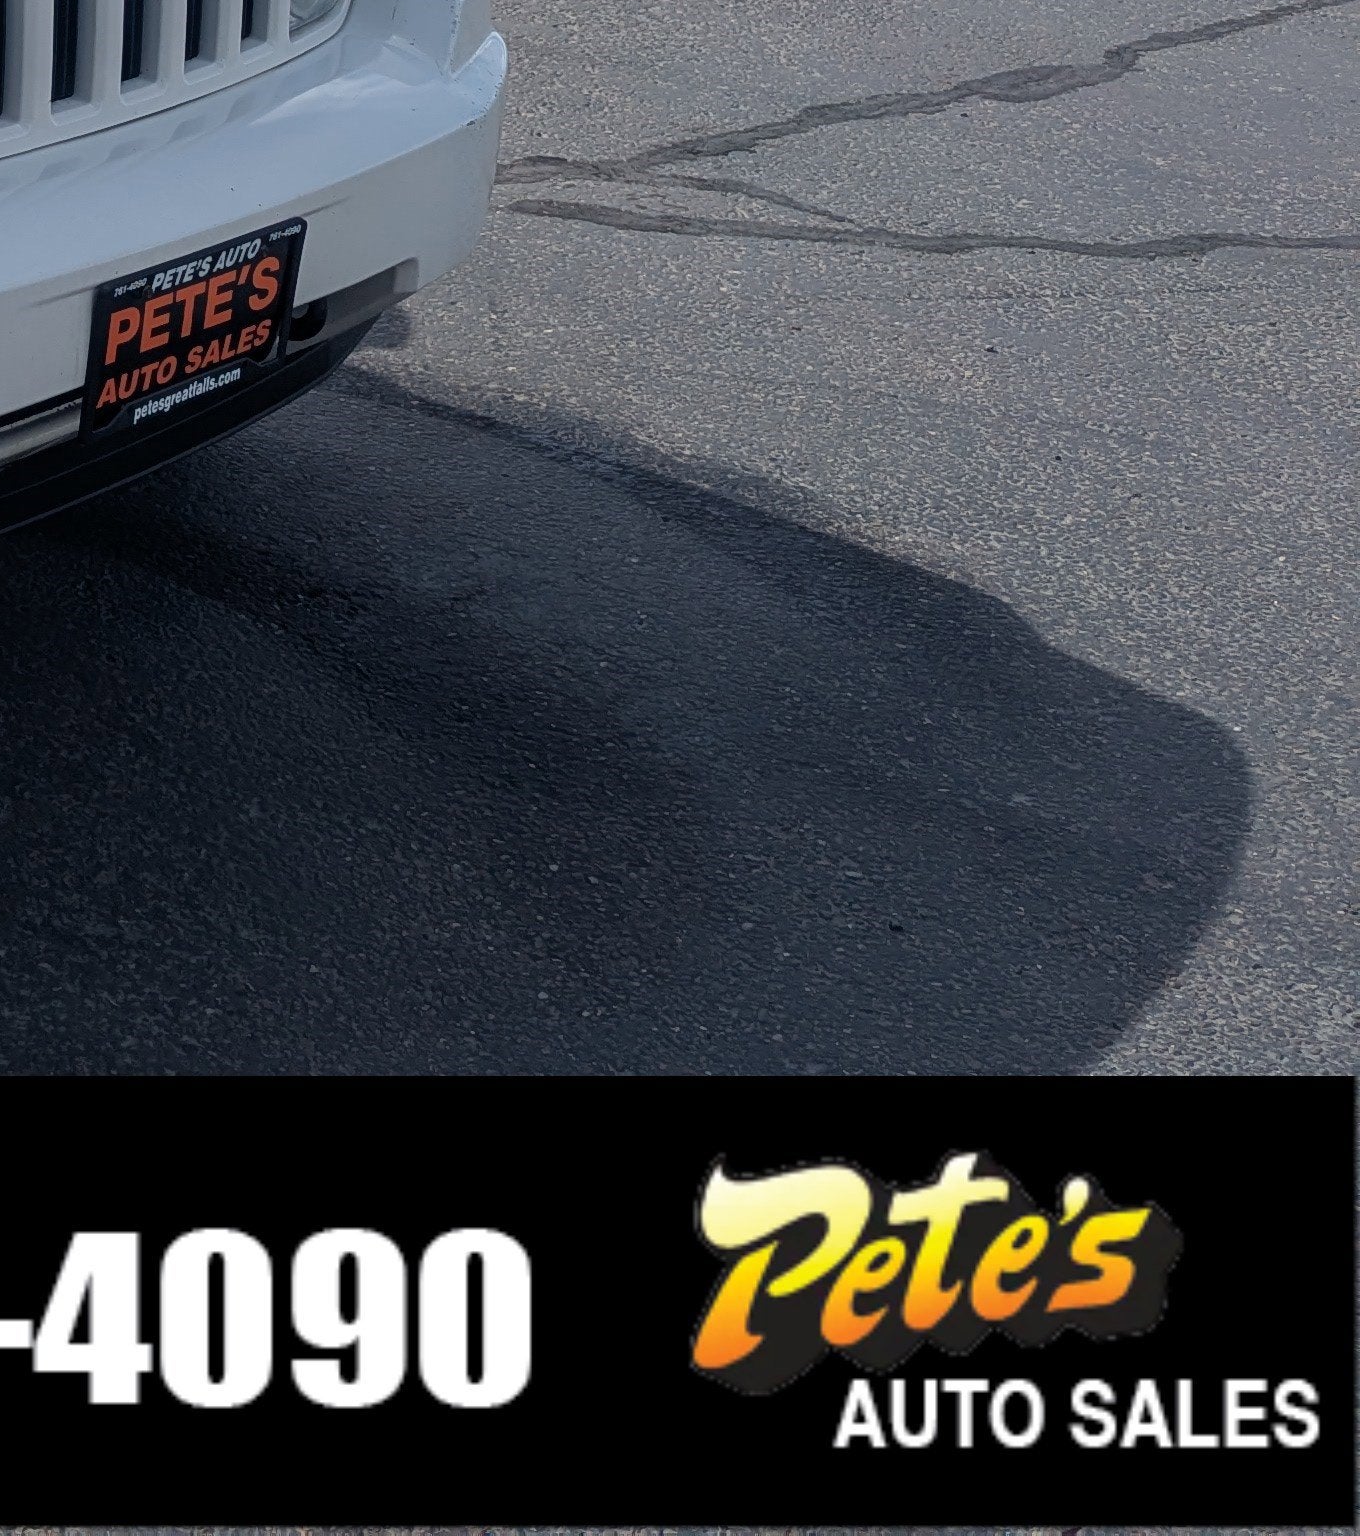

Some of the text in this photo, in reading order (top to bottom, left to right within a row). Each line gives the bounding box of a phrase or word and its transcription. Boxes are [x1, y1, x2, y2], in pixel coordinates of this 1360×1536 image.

[151, 256, 213, 293] PETE'S
[212, 238, 262, 272] AUTO
[105, 256, 280, 366] PETE'S
[95, 319, 272, 409] AUTO SALES
[133, 367, 242, 425] petesgreatfalls.com
